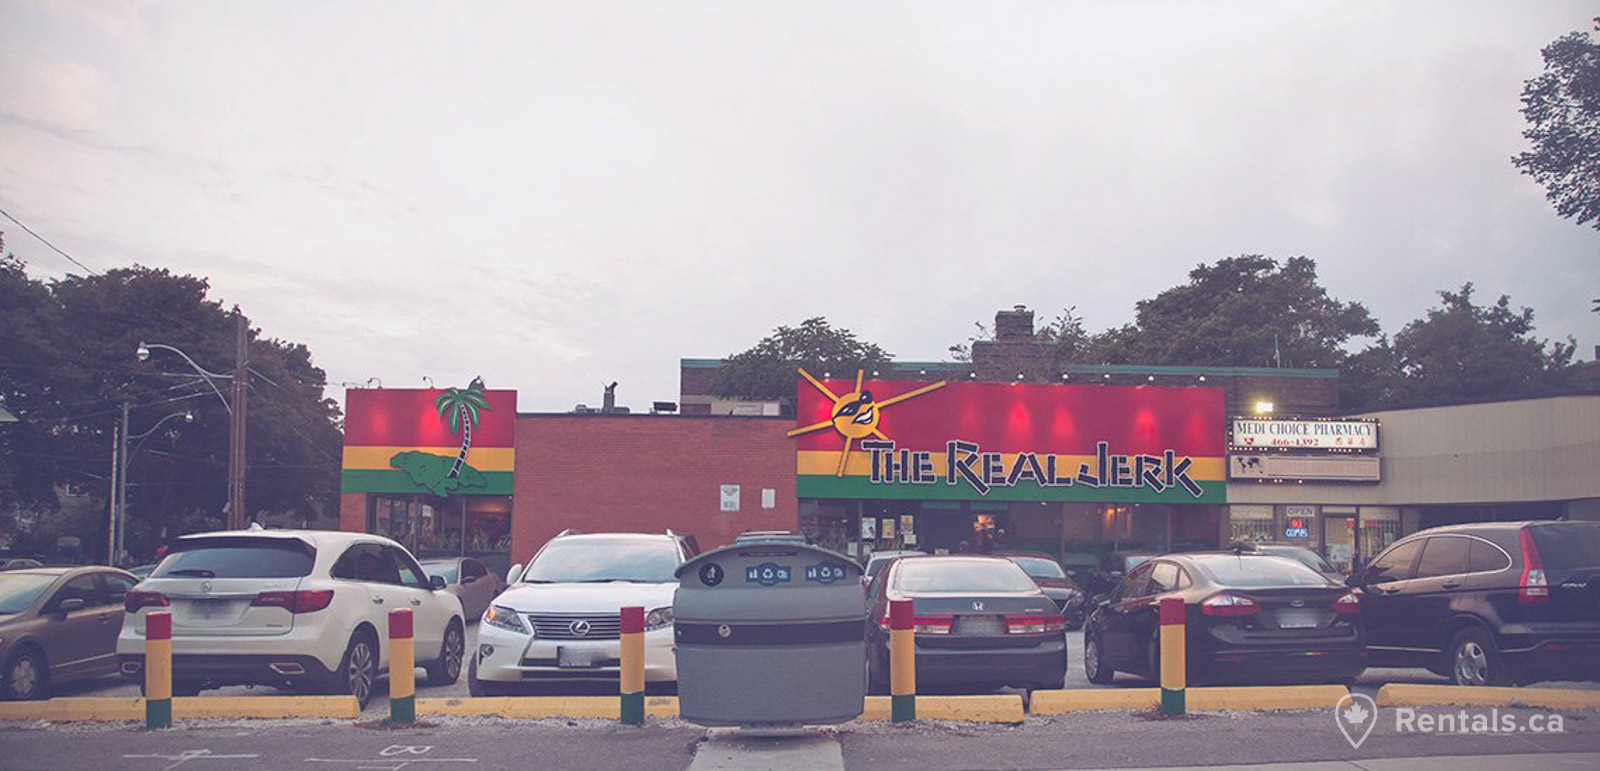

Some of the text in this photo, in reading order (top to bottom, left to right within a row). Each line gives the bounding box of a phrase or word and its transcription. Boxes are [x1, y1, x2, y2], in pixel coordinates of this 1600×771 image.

[1236, 422, 1371, 436] MEDI CHOICE PHARMACY
[1270, 438, 1319, 446] 466-1392
[861, 440, 1204, 498] THE REAL JERK
